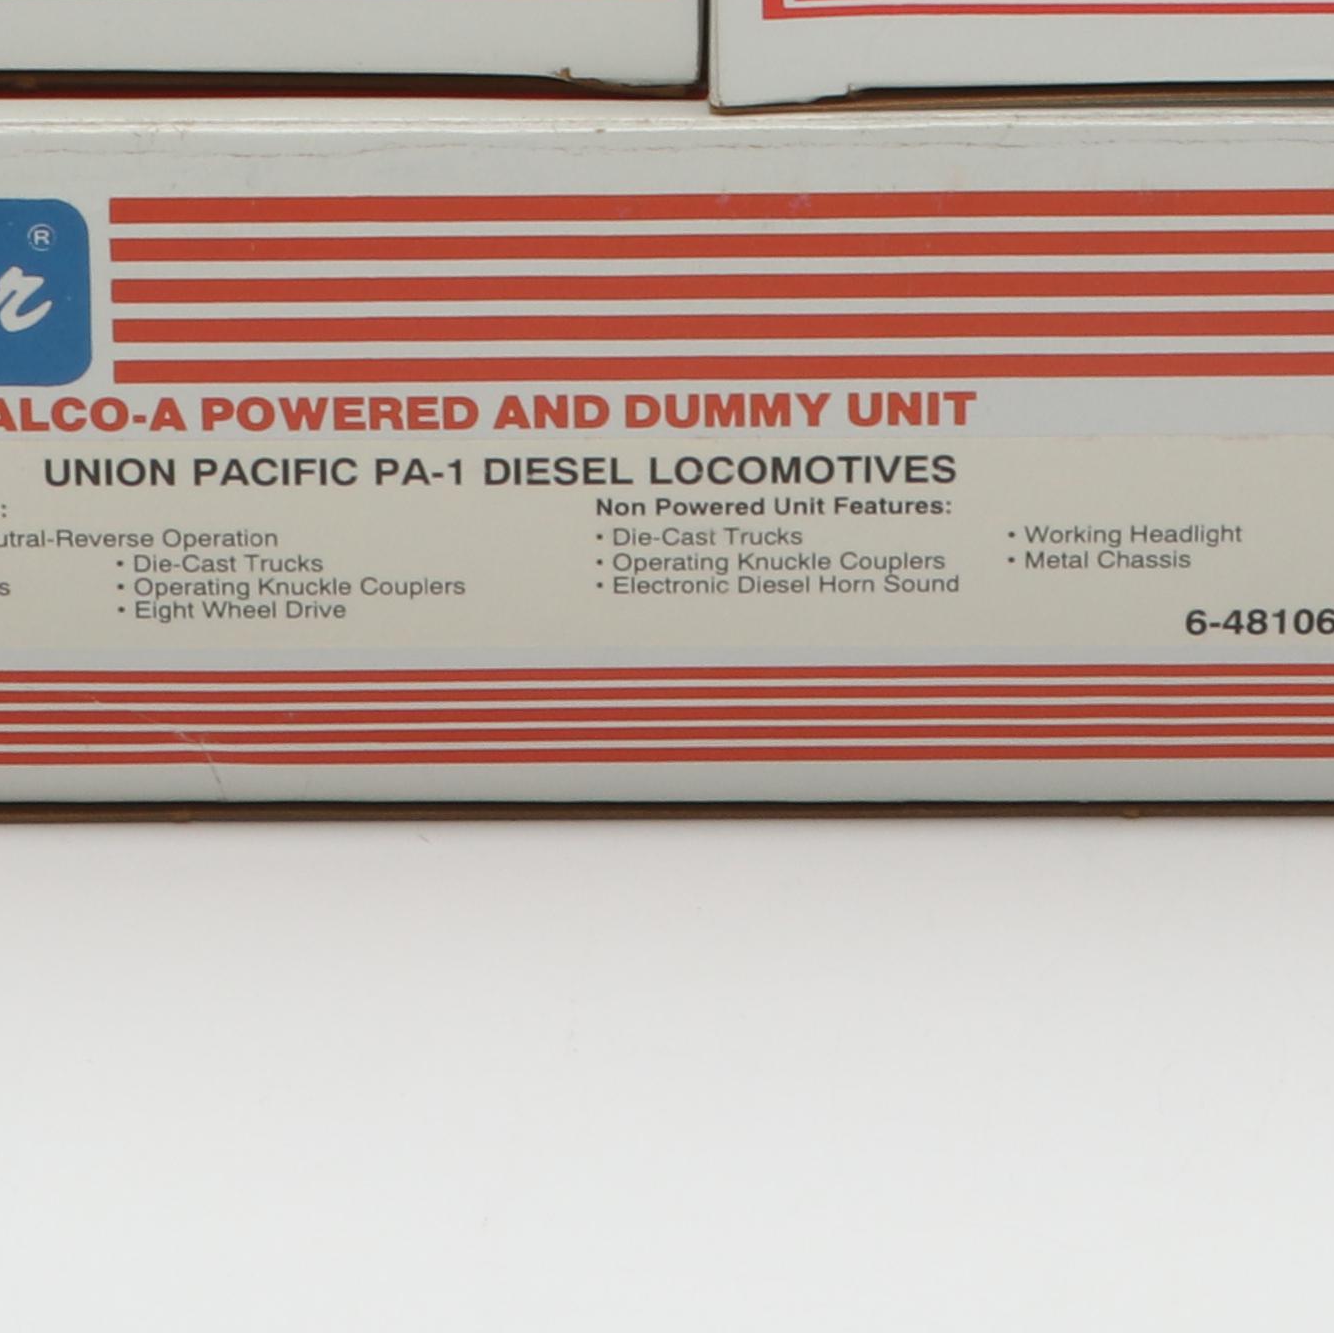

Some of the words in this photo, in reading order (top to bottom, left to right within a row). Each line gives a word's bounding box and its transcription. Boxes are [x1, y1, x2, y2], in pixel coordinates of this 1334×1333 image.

[203, 397, 480, 433] POWERED
[496, 396, 610, 430] AND
[626, 394, 831, 430] DUMMY
[849, 392, 977, 428] UNIT
[45, 459, 176, 488] UNION
[194, 458, 358, 488] PACIFIC
[376, 459, 463, 487] PA-1
[485, 457, 635, 487] DIESEL
[651, 455, 957, 486] LOCOMOTIVES
[597, 499, 647, 517] Non
[656, 498, 766, 517] Powered
[775, 498, 825, 517] Unit
[835, 497, 952, 516] Features:
[163, 529, 279, 552] Operation
[614, 528, 716, 548] Die-Cast
[724, 528, 804, 547] Trucks
[1025, 526, 1123, 549] Working
[1131, 526, 1243, 549] Headlight
[135, 555, 237, 574] Die-Cast
[245, 555, 325, 574] Trucks
[613, 553, 730, 577] Operating
[739, 554, 833, 572] Knuckle
[840, 552, 947, 577] Couplers
[1026, 551, 1090, 570] Metal
[1098, 551, 1192, 570] Chassis
[135, 578, 251, 602] Operating
[259, 579, 353, 597] Knuckle
[361, 577, 467, 600] Couplers
[614, 576, 729, 596] Electronic
[739, 576, 811, 595] Diesel
[820, 576, 876, 595] Horn
[885, 574, 960, 594] Sound
[136, 601, 195, 625] Eight
[203, 598, 278, 620] Wheel
[287, 601, 347, 620] Drive
